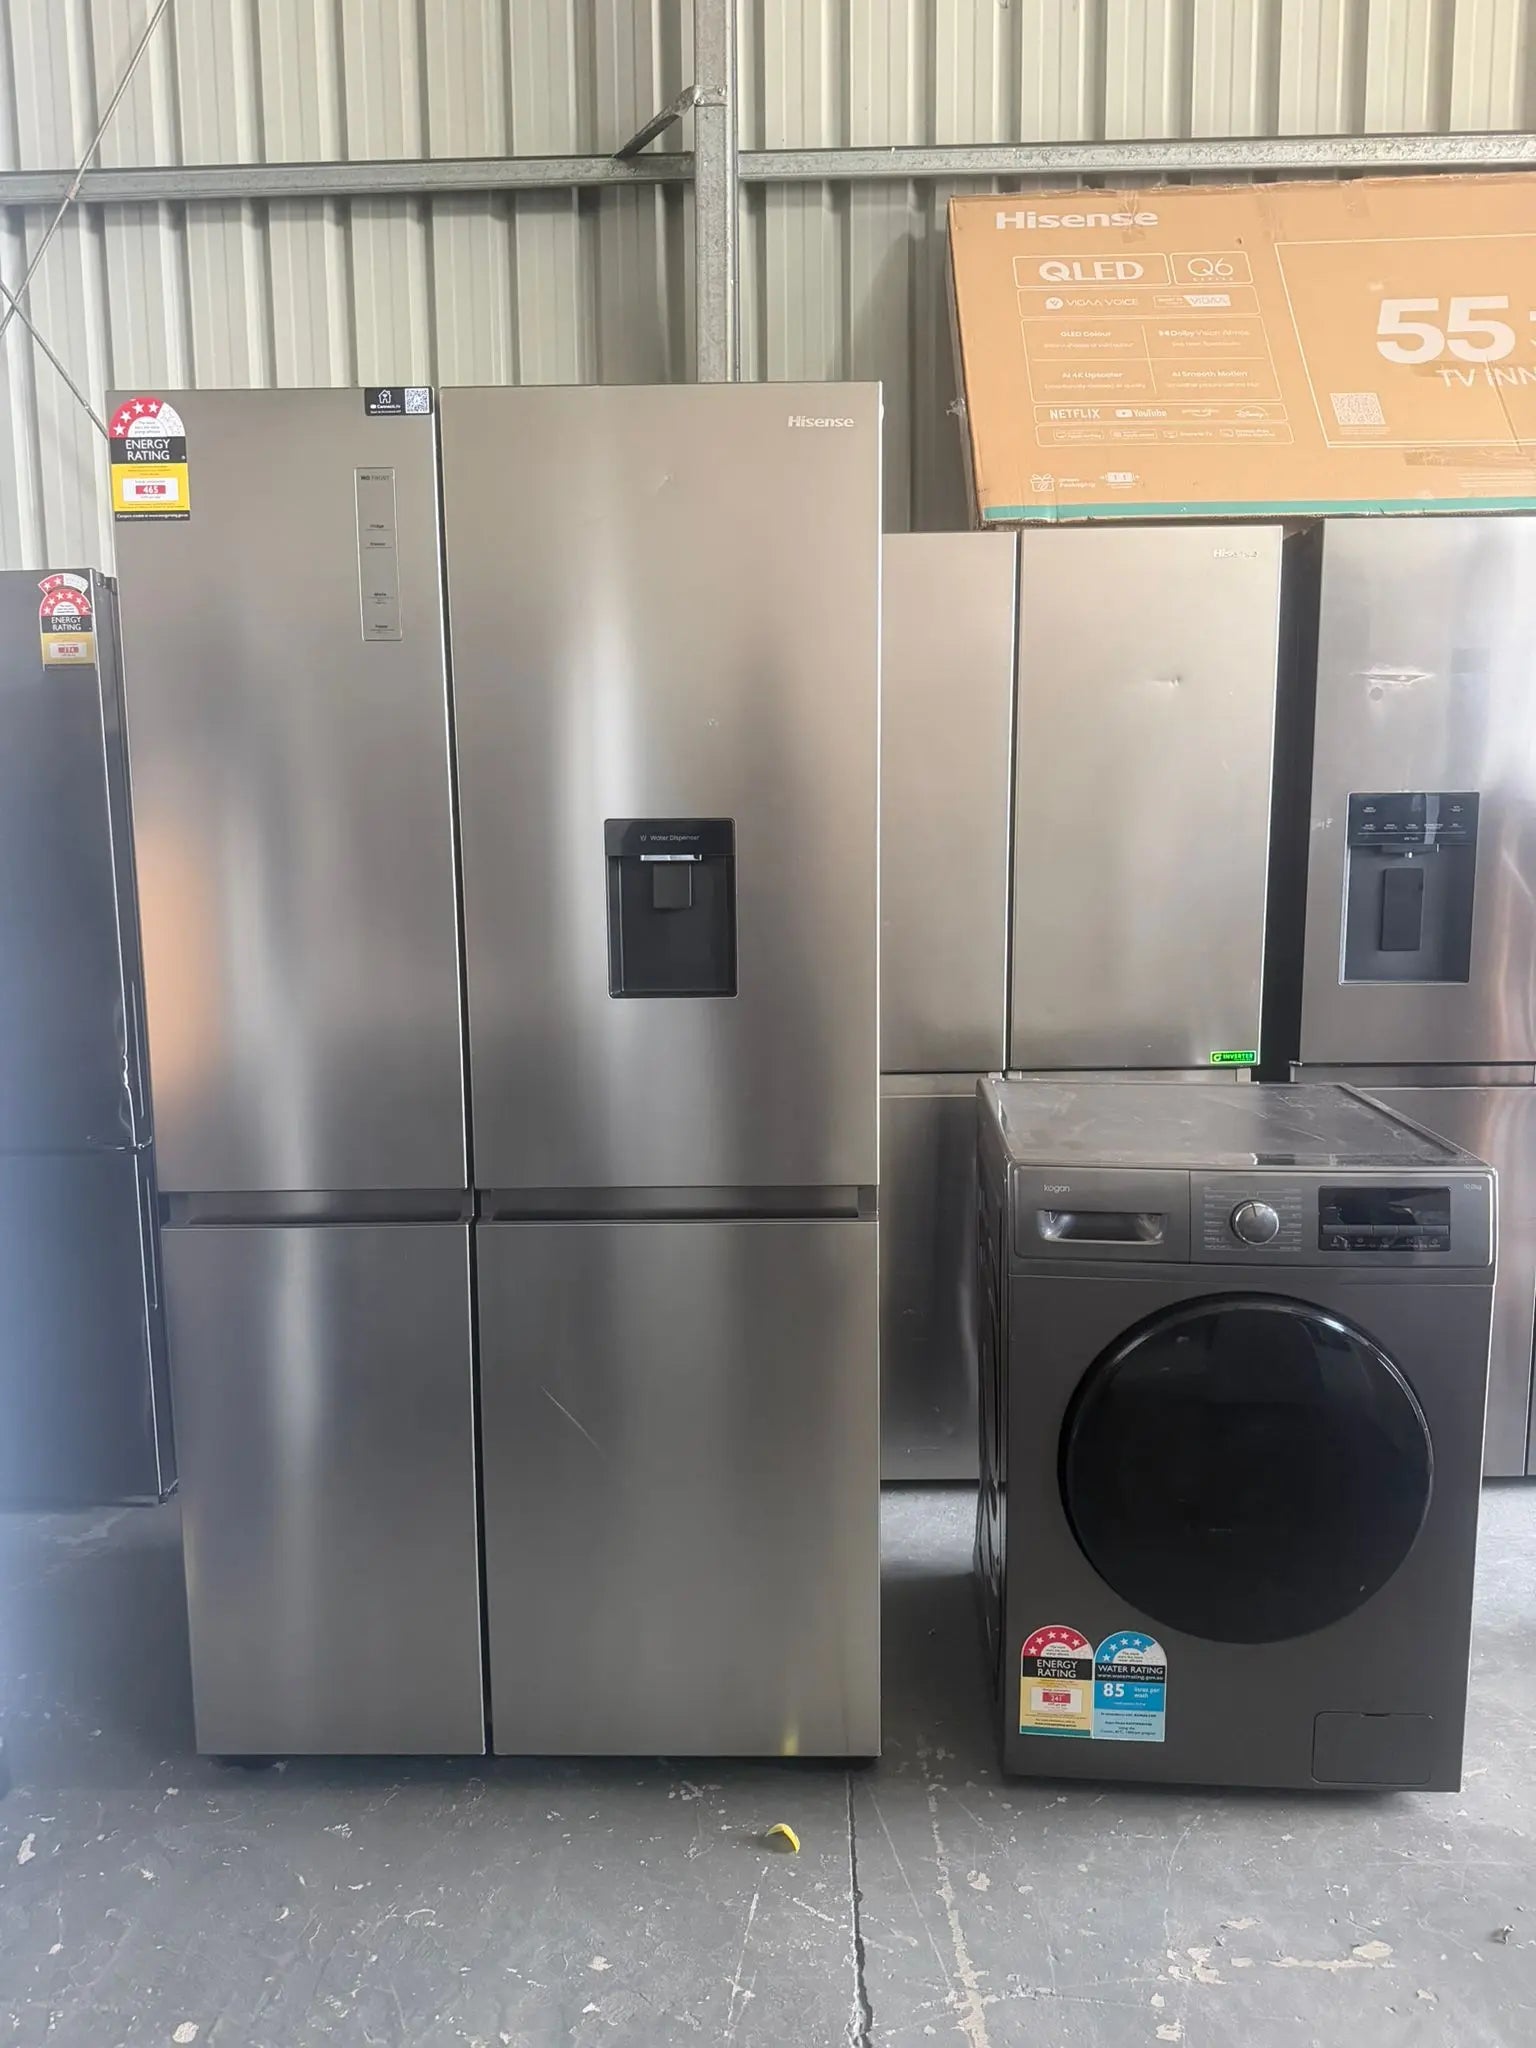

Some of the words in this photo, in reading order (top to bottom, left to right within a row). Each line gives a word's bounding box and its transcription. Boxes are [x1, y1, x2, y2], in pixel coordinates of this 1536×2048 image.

[996, 211, 1159, 230] Hisense
[1039, 260, 1144, 282] QLED
[1187, 257, 1234, 277] Q6
[1376, 295, 1516, 364] 55
[1435, 367, 1475, 388] TV
[1050, 408, 1101, 420] NETFLIX
[1133, 408, 1168, 418] YouTube
[787, 415, 855, 427] Hisense
[125, 439, 171, 450] ENERGY
[127, 450, 171, 461] RATING
[143, 486, 159, 494] 465
[670, 833, 700, 842] Dispenser
[1043, 1184, 1070, 1194] kogan
[1036, 1658, 1078, 1670] ENERGY
[1098, 1664, 1129, 1673] WATER
[1130, 1665, 1164, 1675] RATING
[1037, 1668, 1077, 1679] RATING
[1103, 1682, 1125, 1698] 85
